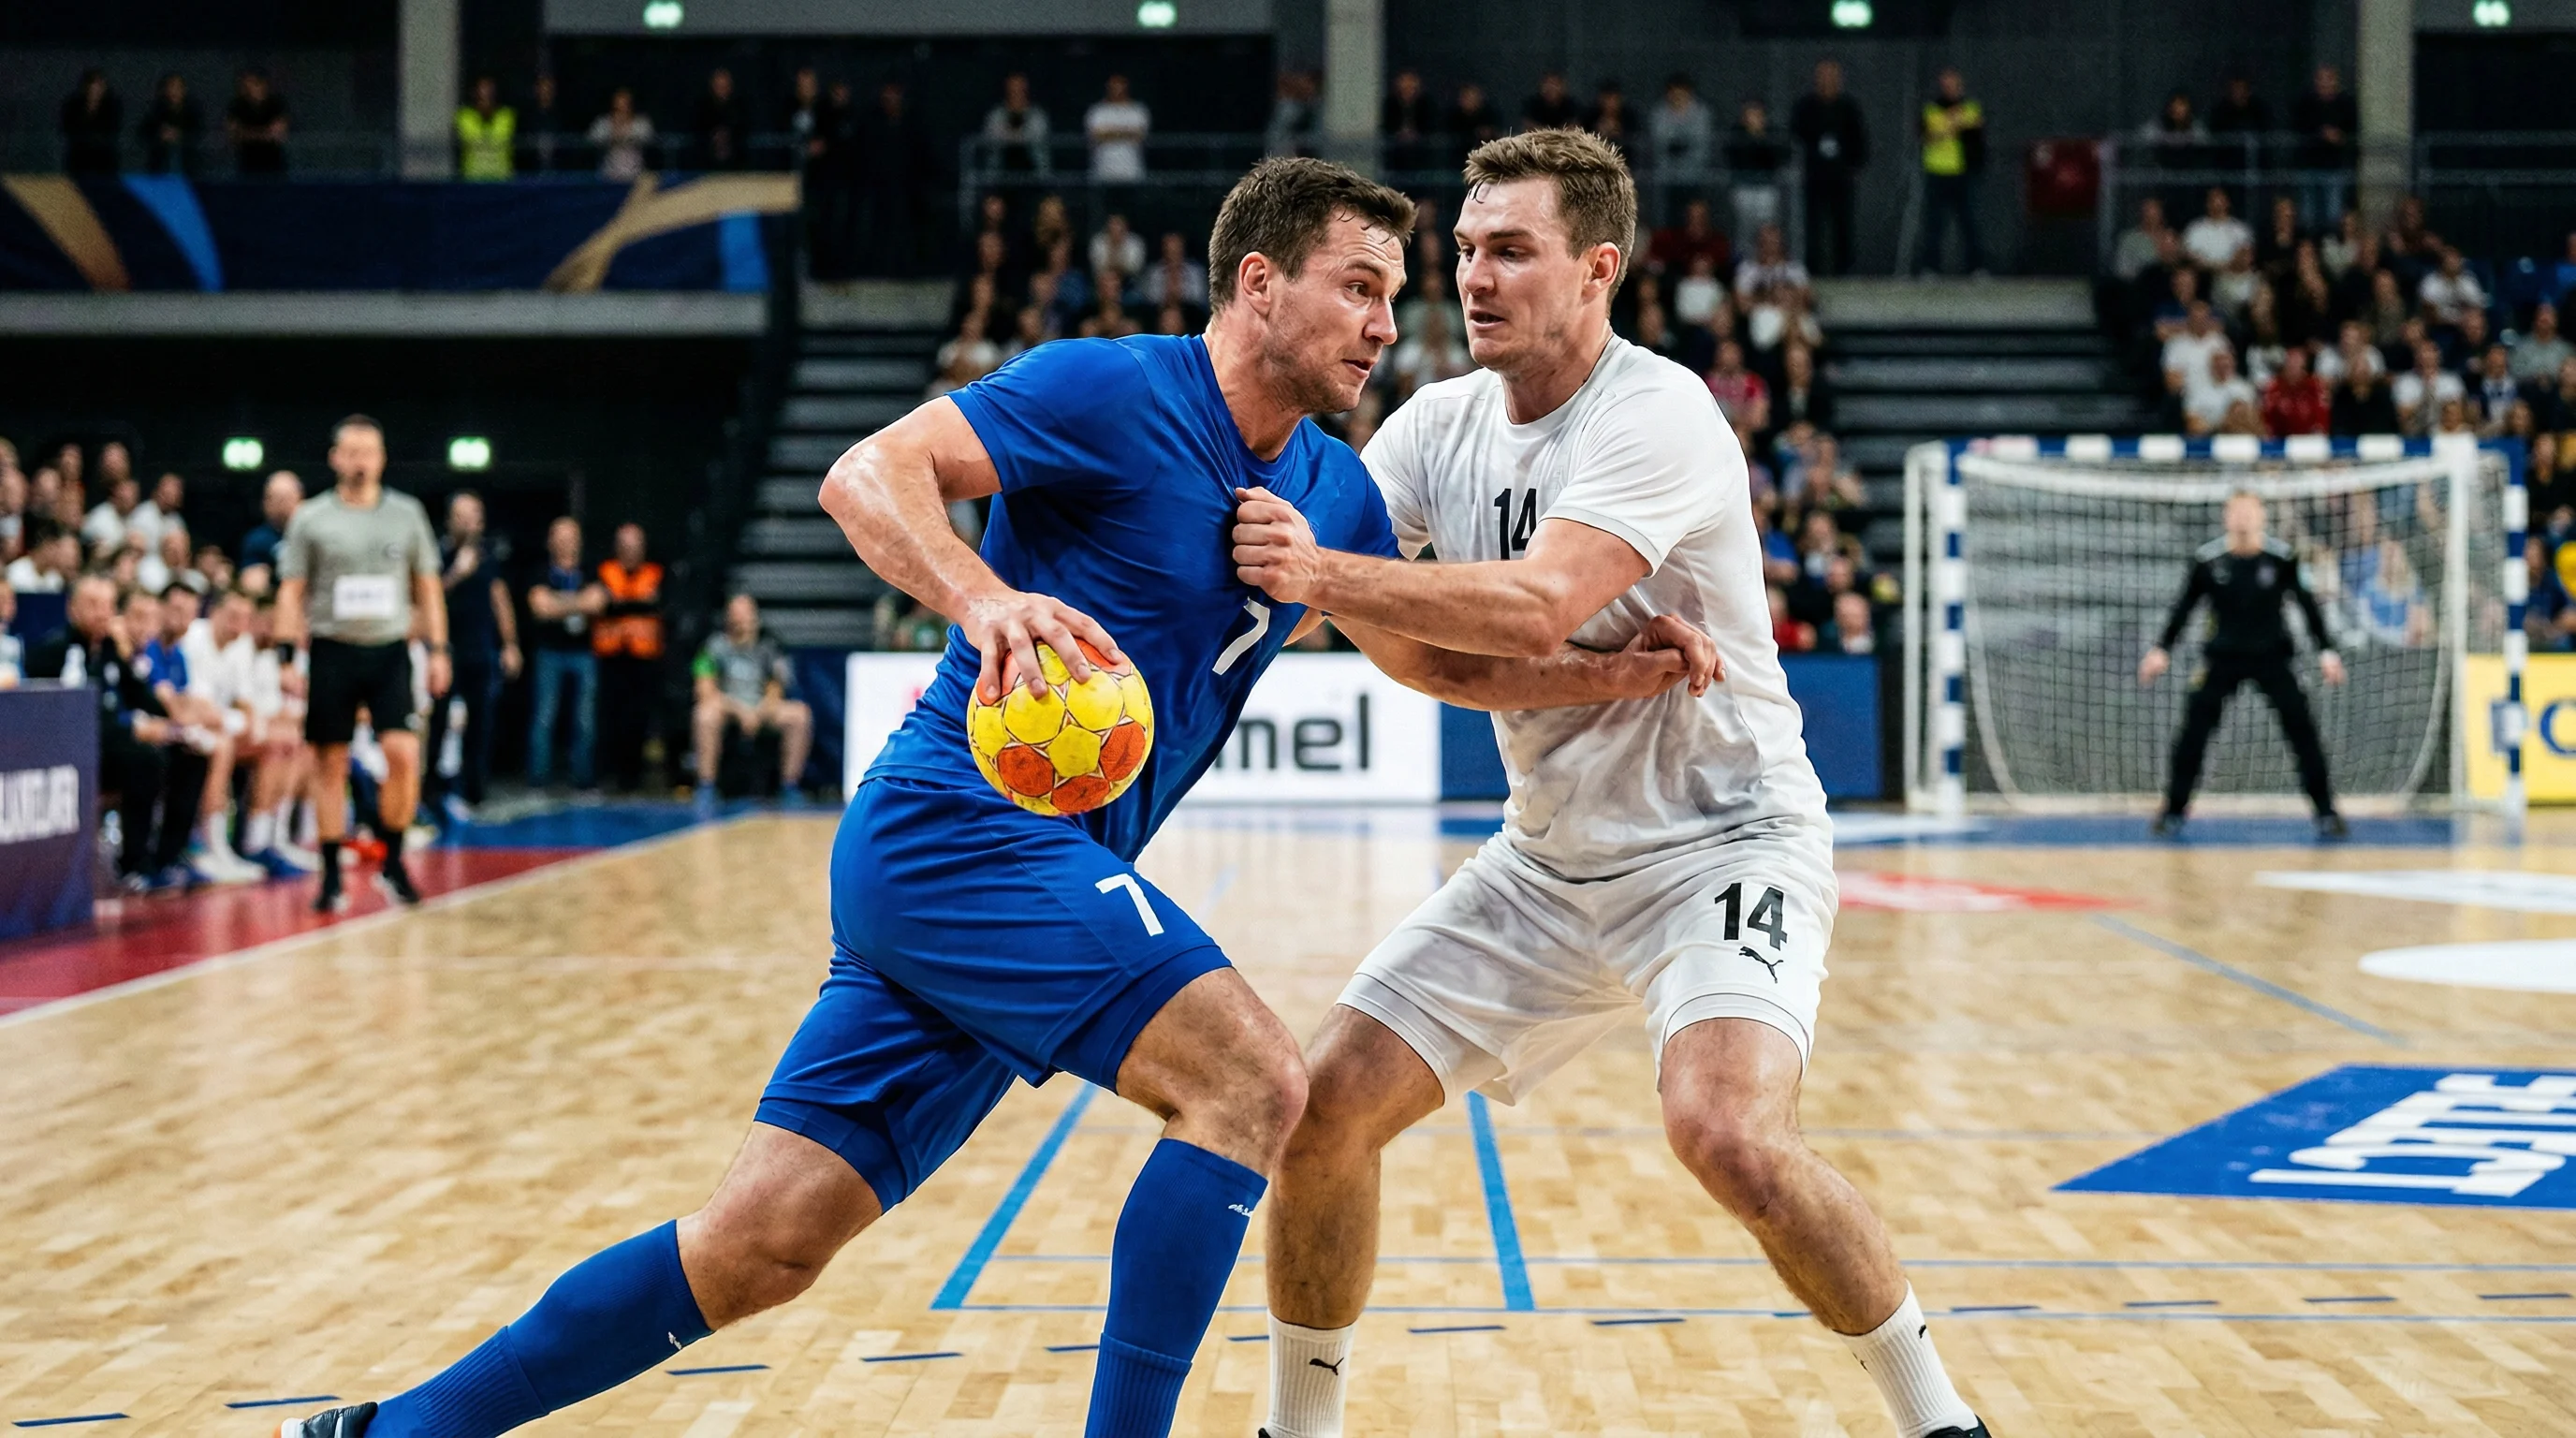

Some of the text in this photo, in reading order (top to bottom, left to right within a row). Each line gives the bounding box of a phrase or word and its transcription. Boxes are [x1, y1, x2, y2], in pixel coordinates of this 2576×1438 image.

[1494, 488, 1537, 561] 14
[1212, 596, 1271, 675] 7
[1094, 873, 1164, 937] 7
[1714, 882, 1788, 951] 14
